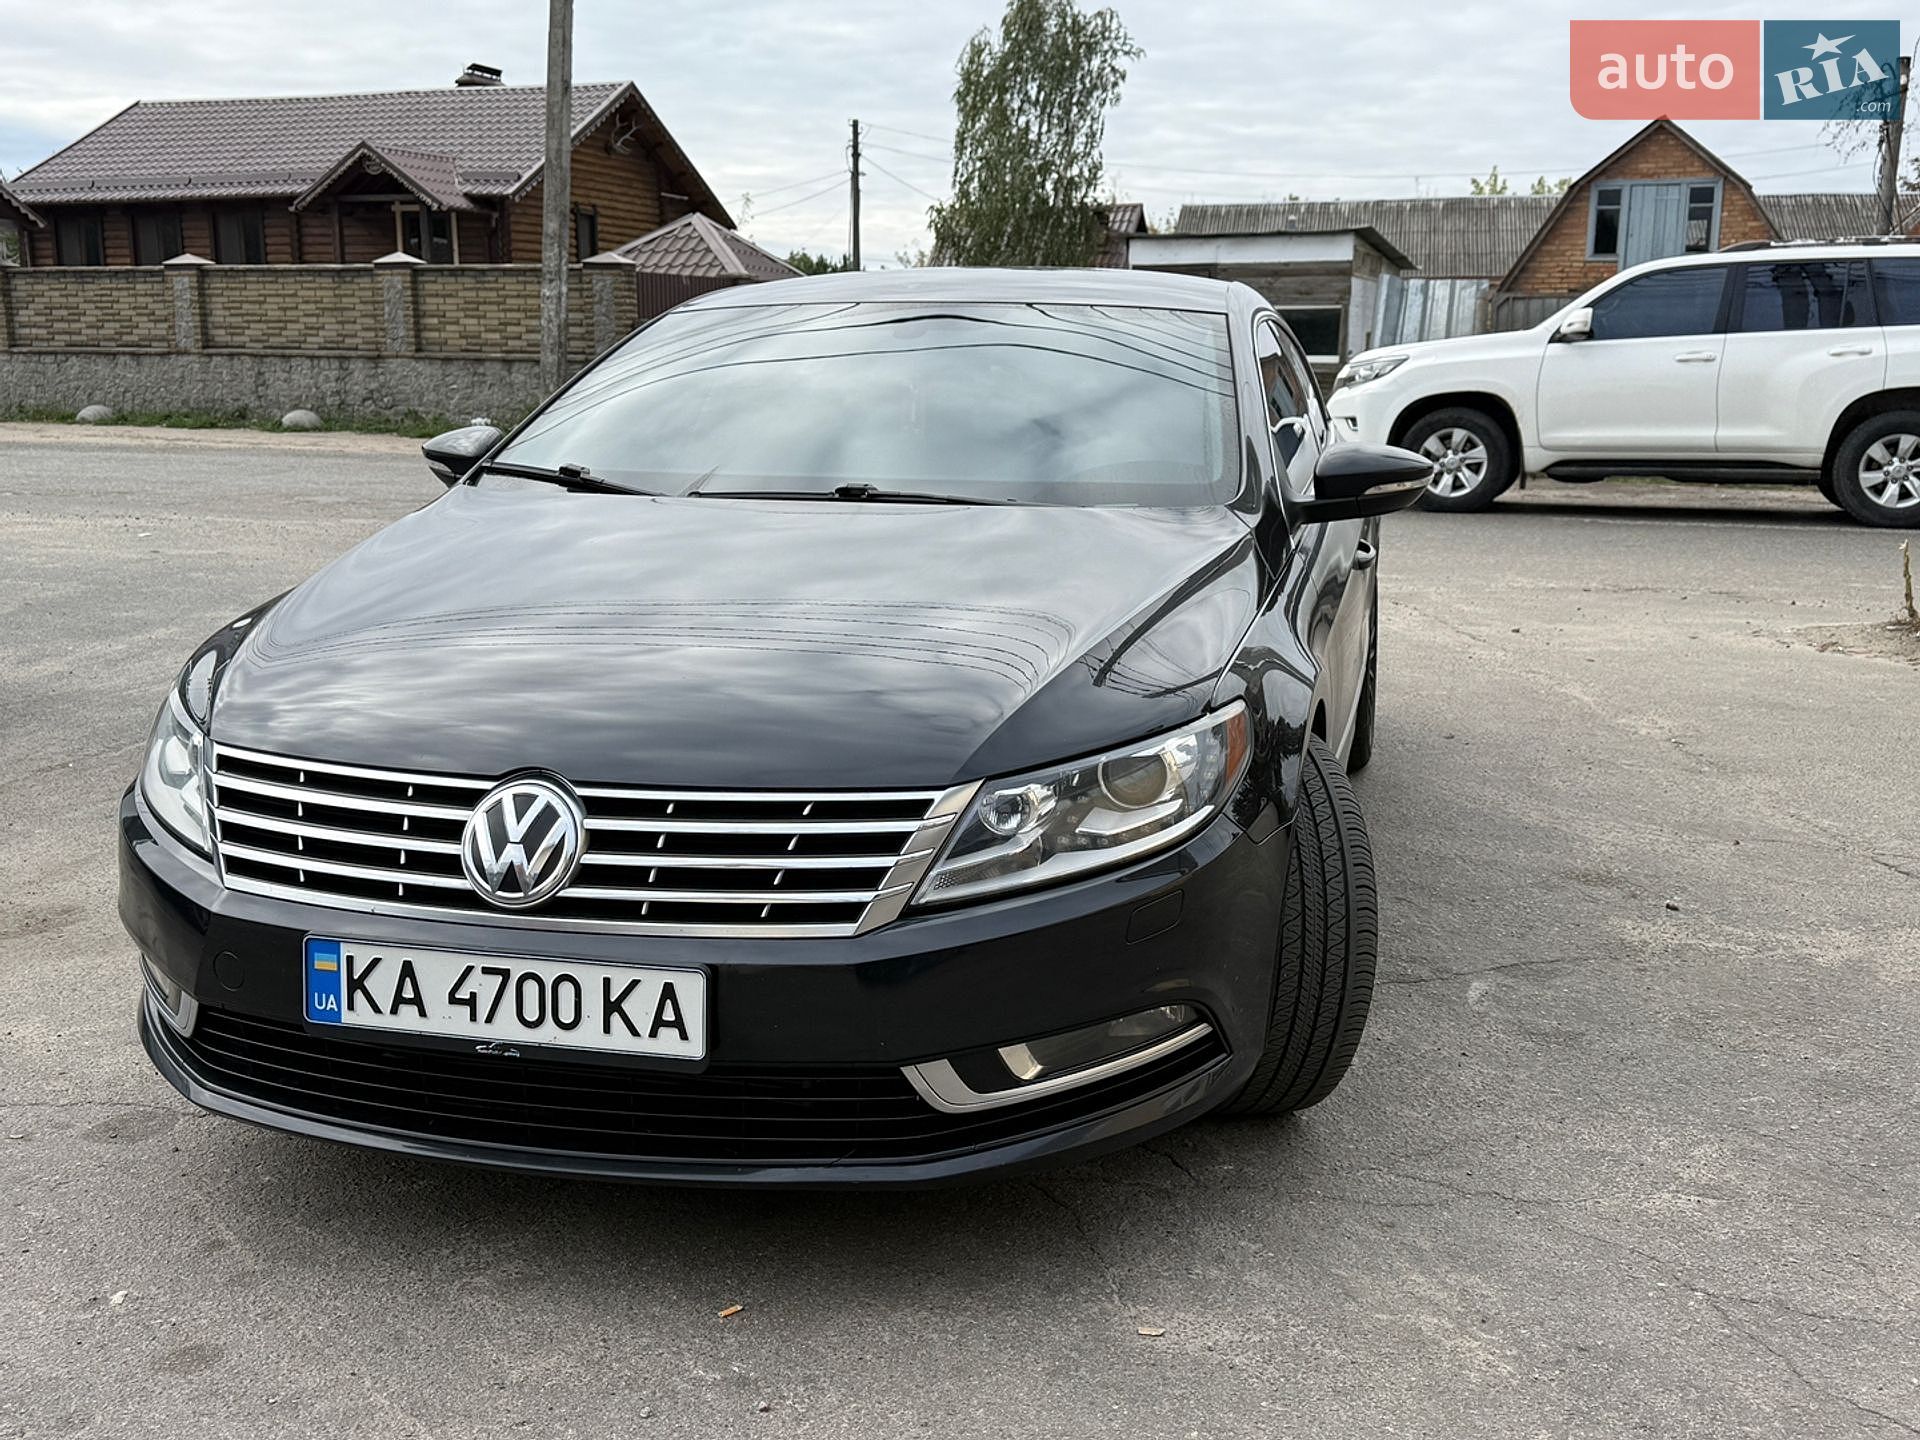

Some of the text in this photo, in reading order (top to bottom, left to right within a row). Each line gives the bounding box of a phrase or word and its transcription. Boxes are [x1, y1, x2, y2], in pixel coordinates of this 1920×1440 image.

[467, 783, 573, 901] VW
[314, 992, 338, 1012] UA
[345, 954, 689, 1041] KA 4700 KA
